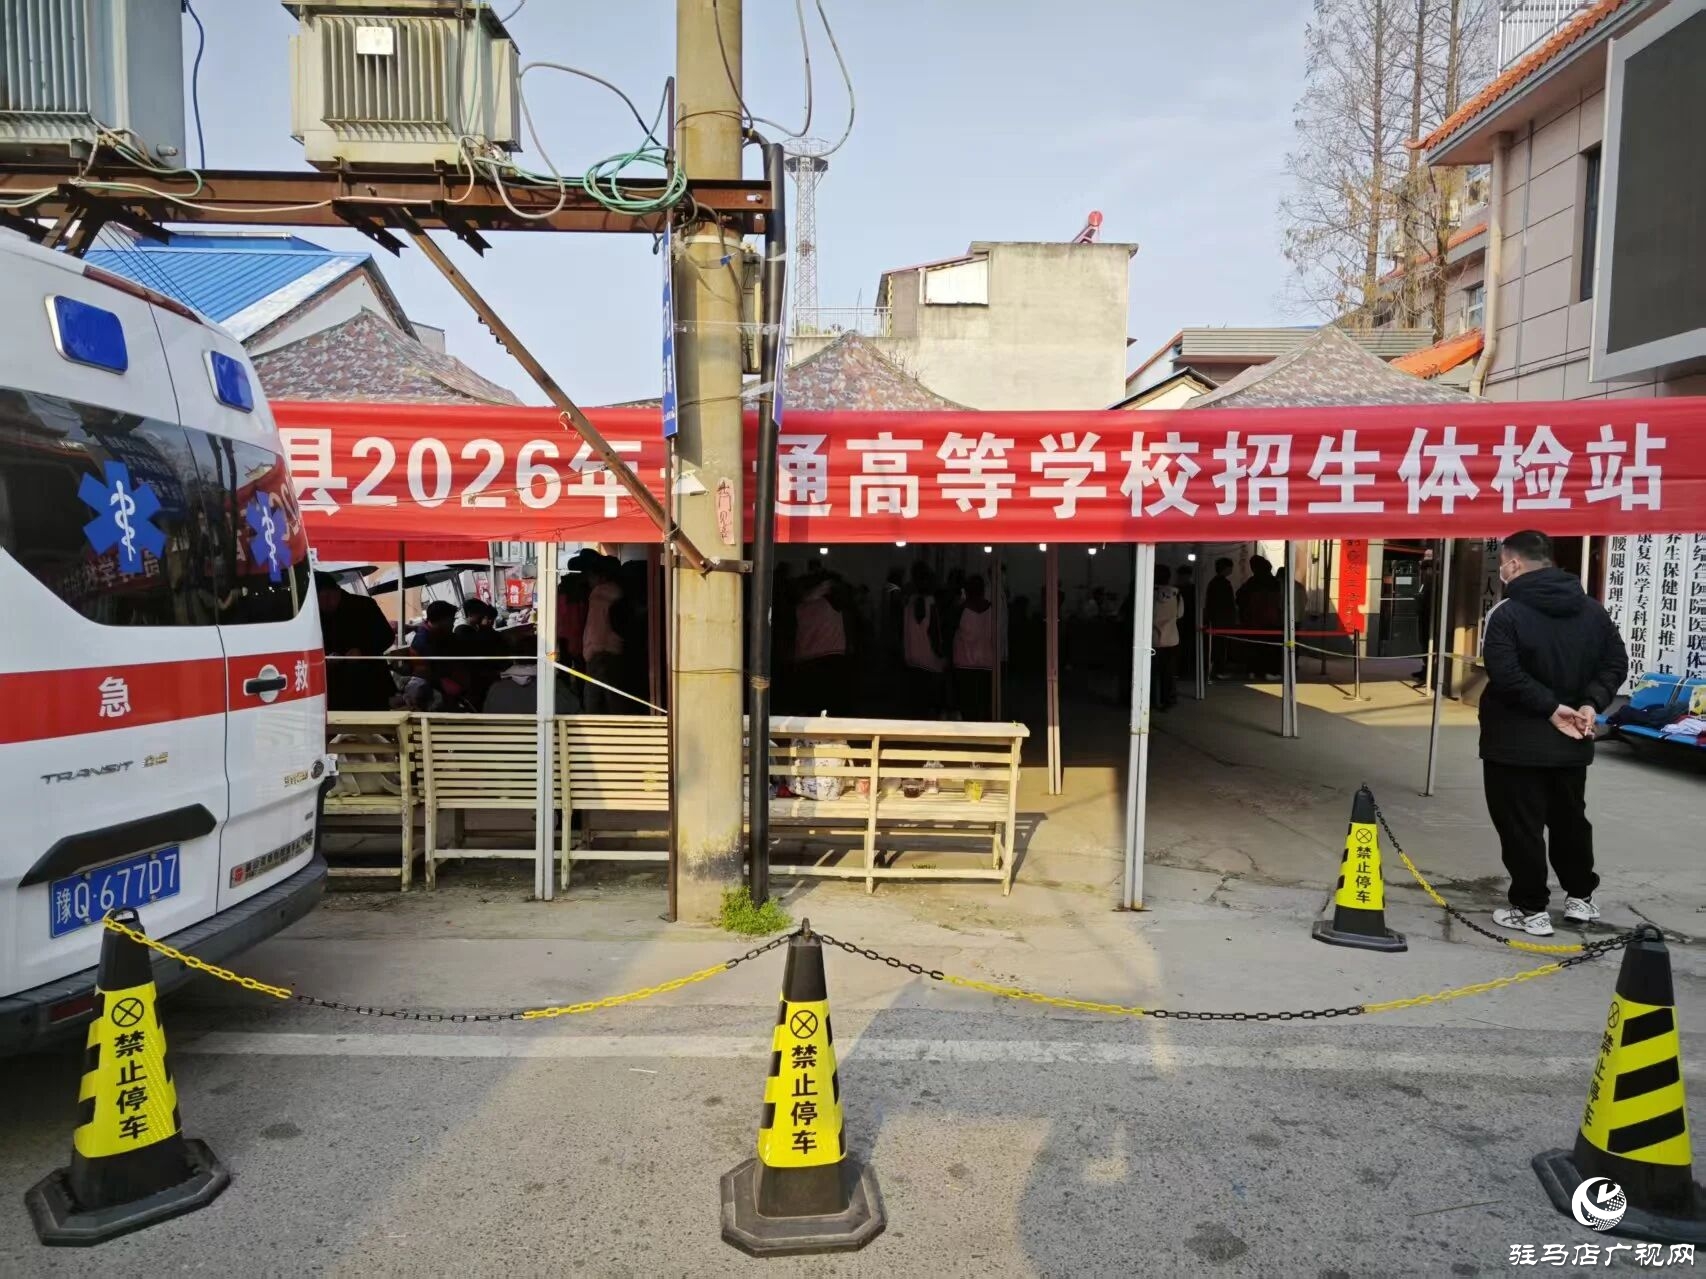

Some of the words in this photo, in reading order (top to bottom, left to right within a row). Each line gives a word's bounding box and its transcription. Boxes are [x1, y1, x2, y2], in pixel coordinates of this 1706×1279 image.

[278, 423, 1666, 519] 县2026年通高等学校招生体检站
[98, 676, 132, 719] 急
[294, 660, 309, 692] 救
[40, 760, 134, 785] TRANSIT
[1355, 845, 1372, 905] 禁止停车
[113, 1030, 149, 1140] 禁止停车
[790, 1044, 818, 1155] 禁止停车
[1583, 1031, 1615, 1128] 禁止停车
